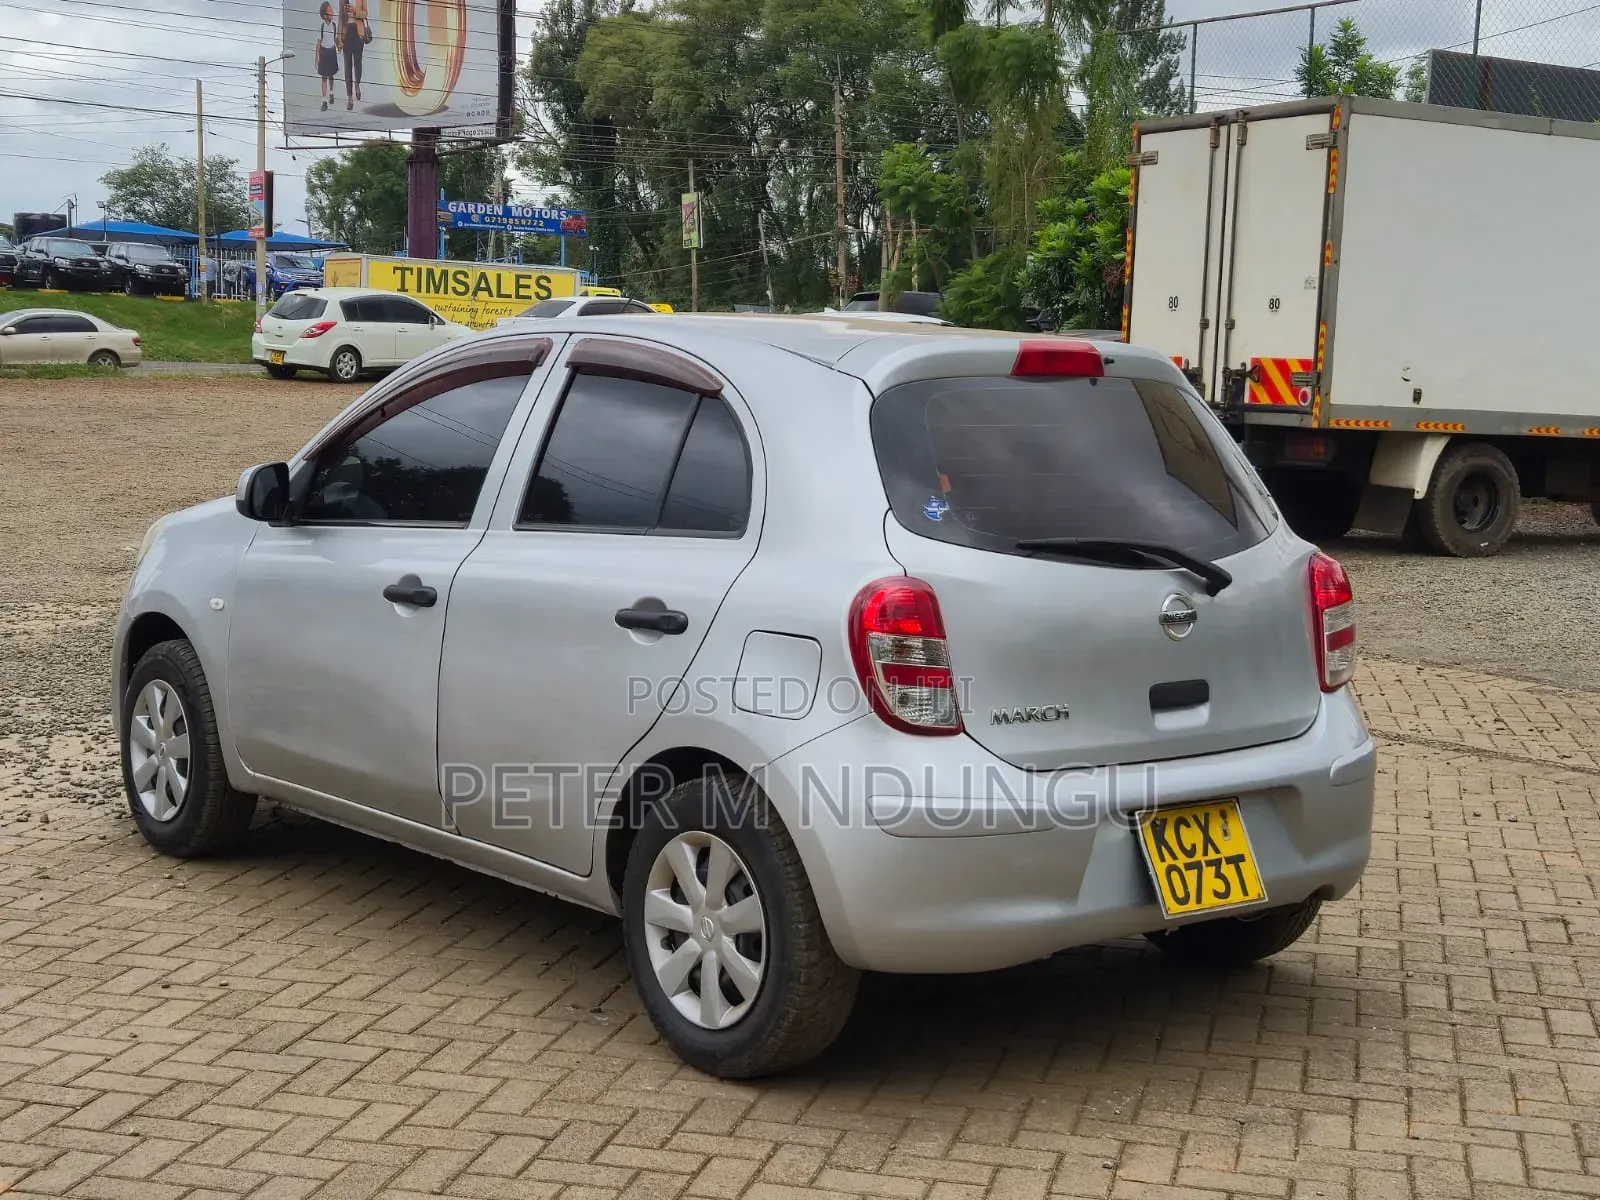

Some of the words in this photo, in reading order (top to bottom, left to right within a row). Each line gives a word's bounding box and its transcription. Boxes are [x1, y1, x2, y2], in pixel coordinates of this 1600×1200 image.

[447, 201, 503, 216] GARDEN
[511, 206, 567, 221] MOTORS
[392, 266, 553, 301] TIMSALES
[434, 303, 479, 318] sustaining
[482, 303, 512, 319] forests
[1168, 296, 1179, 309] 80
[1268, 298, 1280, 310] 80
[990, 703, 1070, 726] MARCH
[1150, 811, 1222, 863] KCX
[1164, 853, 1250, 906] 073T
